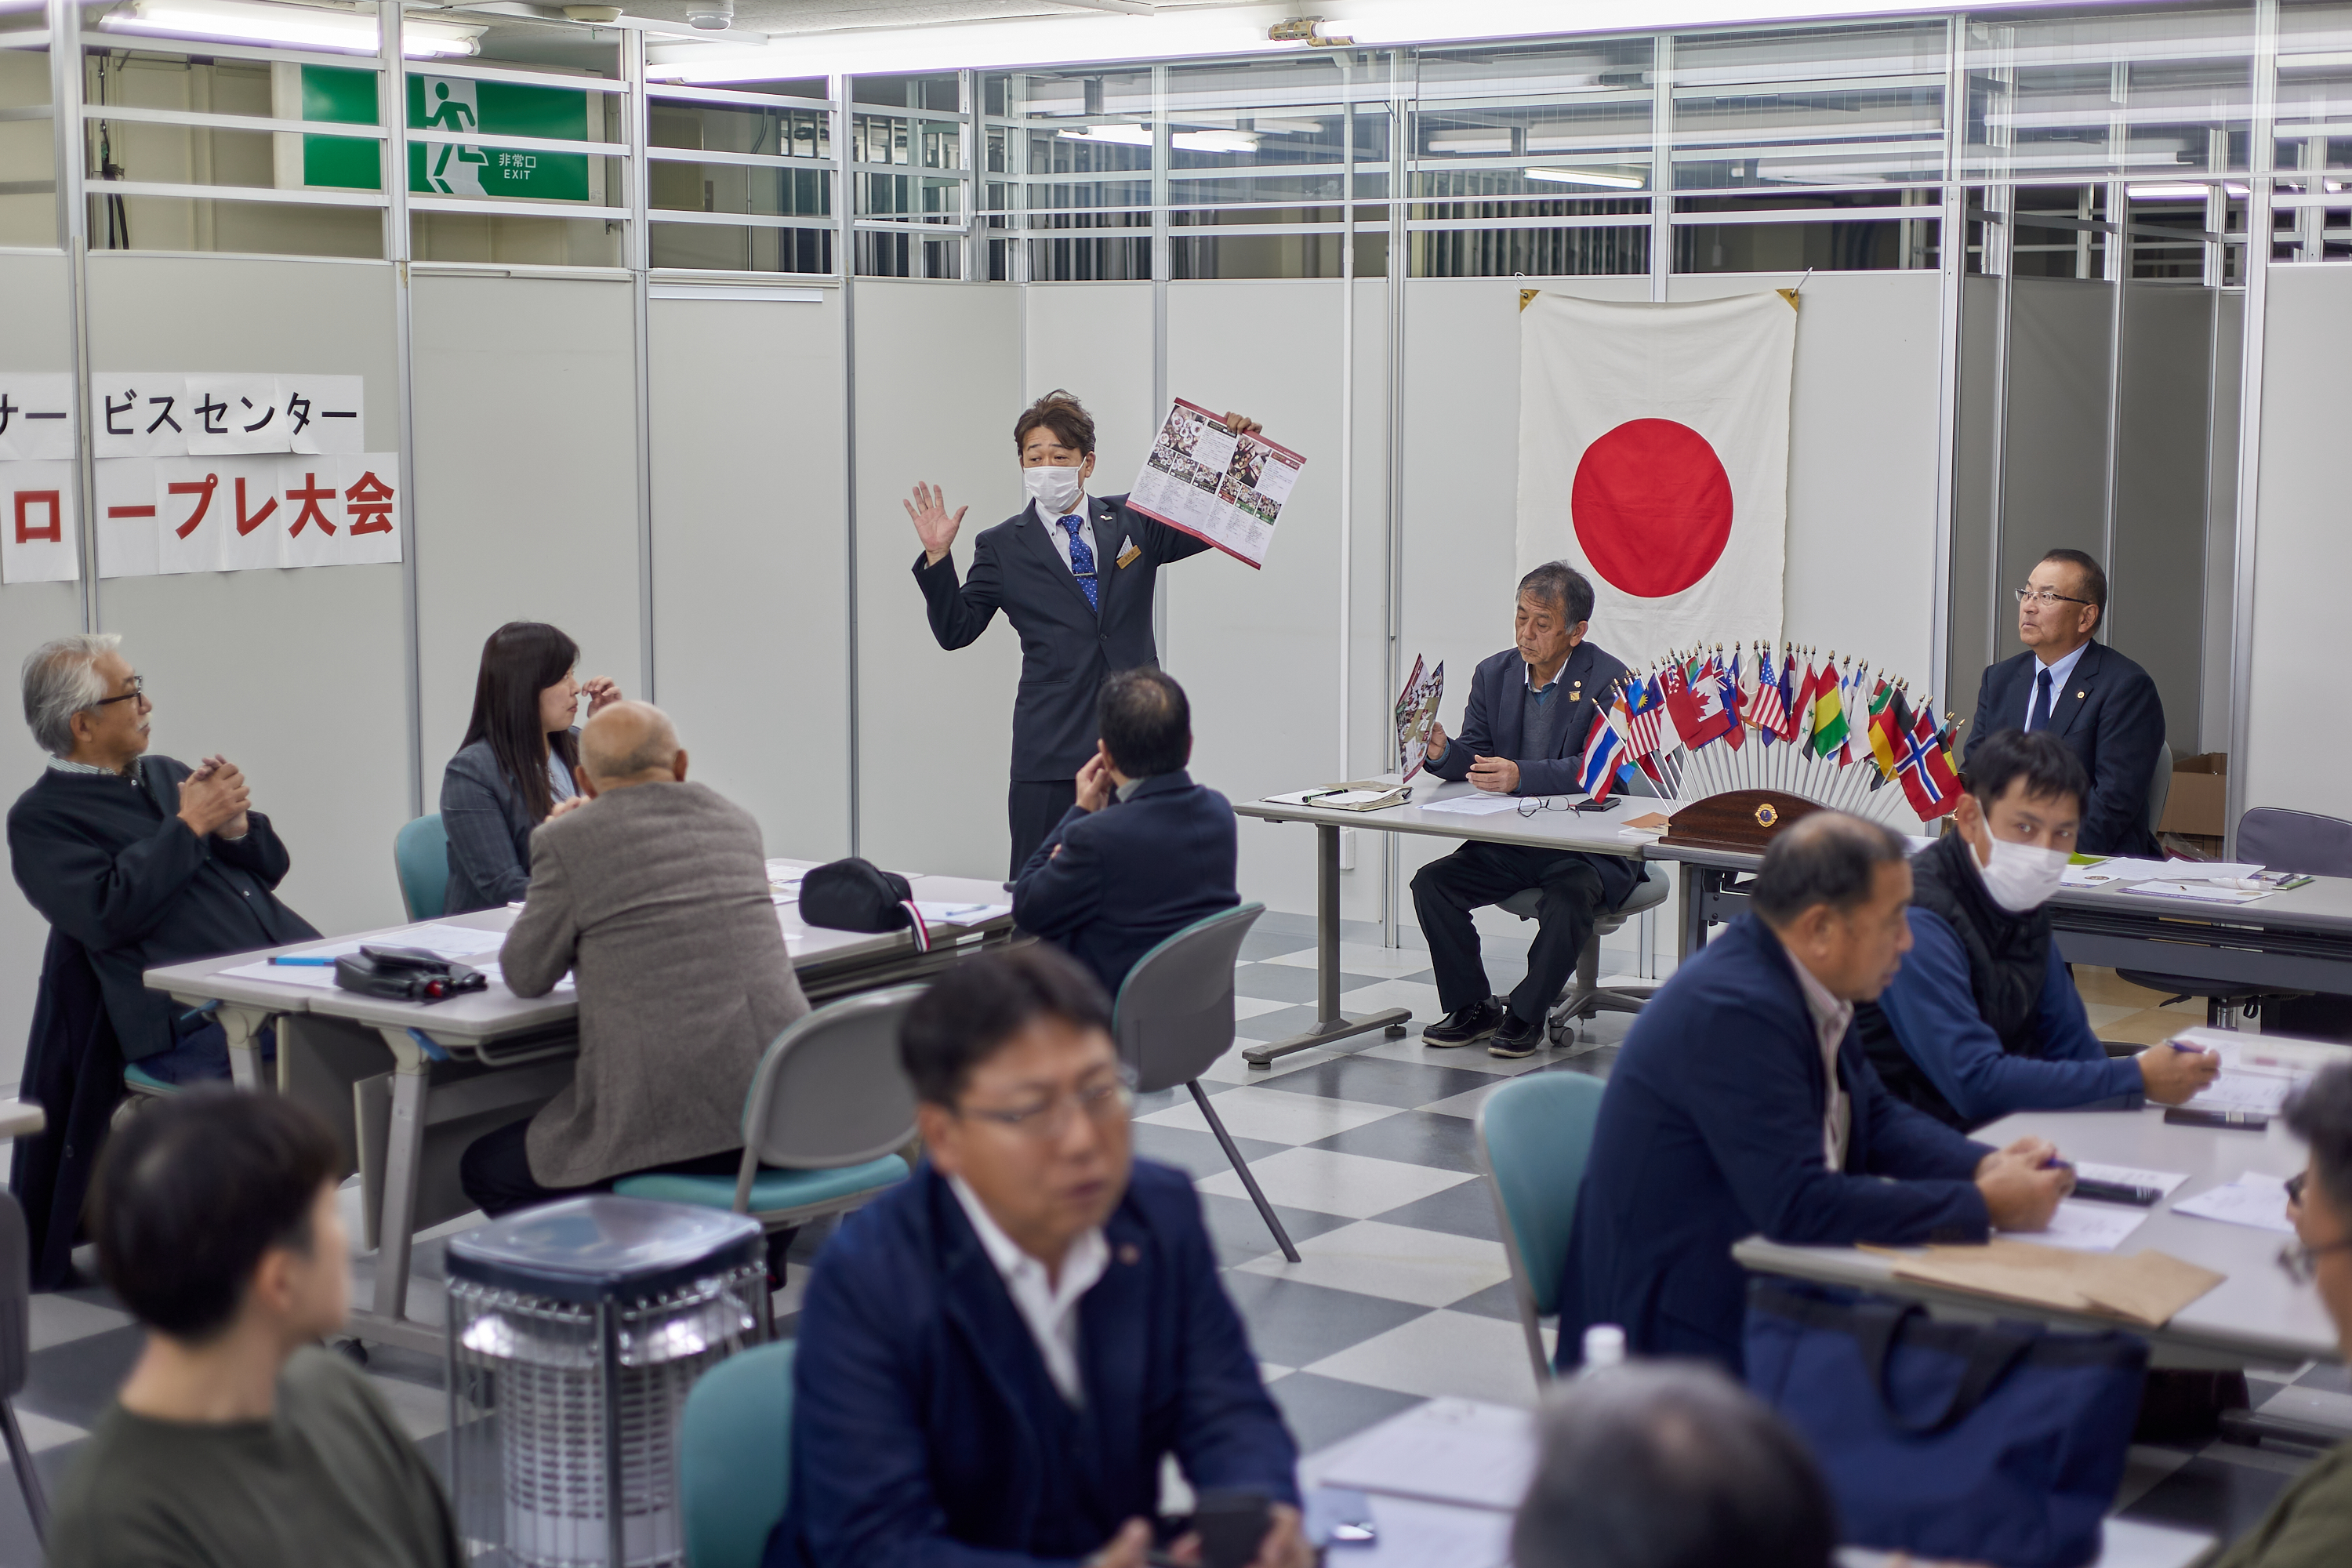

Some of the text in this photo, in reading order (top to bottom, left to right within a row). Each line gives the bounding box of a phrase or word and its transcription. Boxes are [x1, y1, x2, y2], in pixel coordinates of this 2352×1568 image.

[499, 153, 536, 168] 非常口
[504, 169, 531, 180] EXIT
